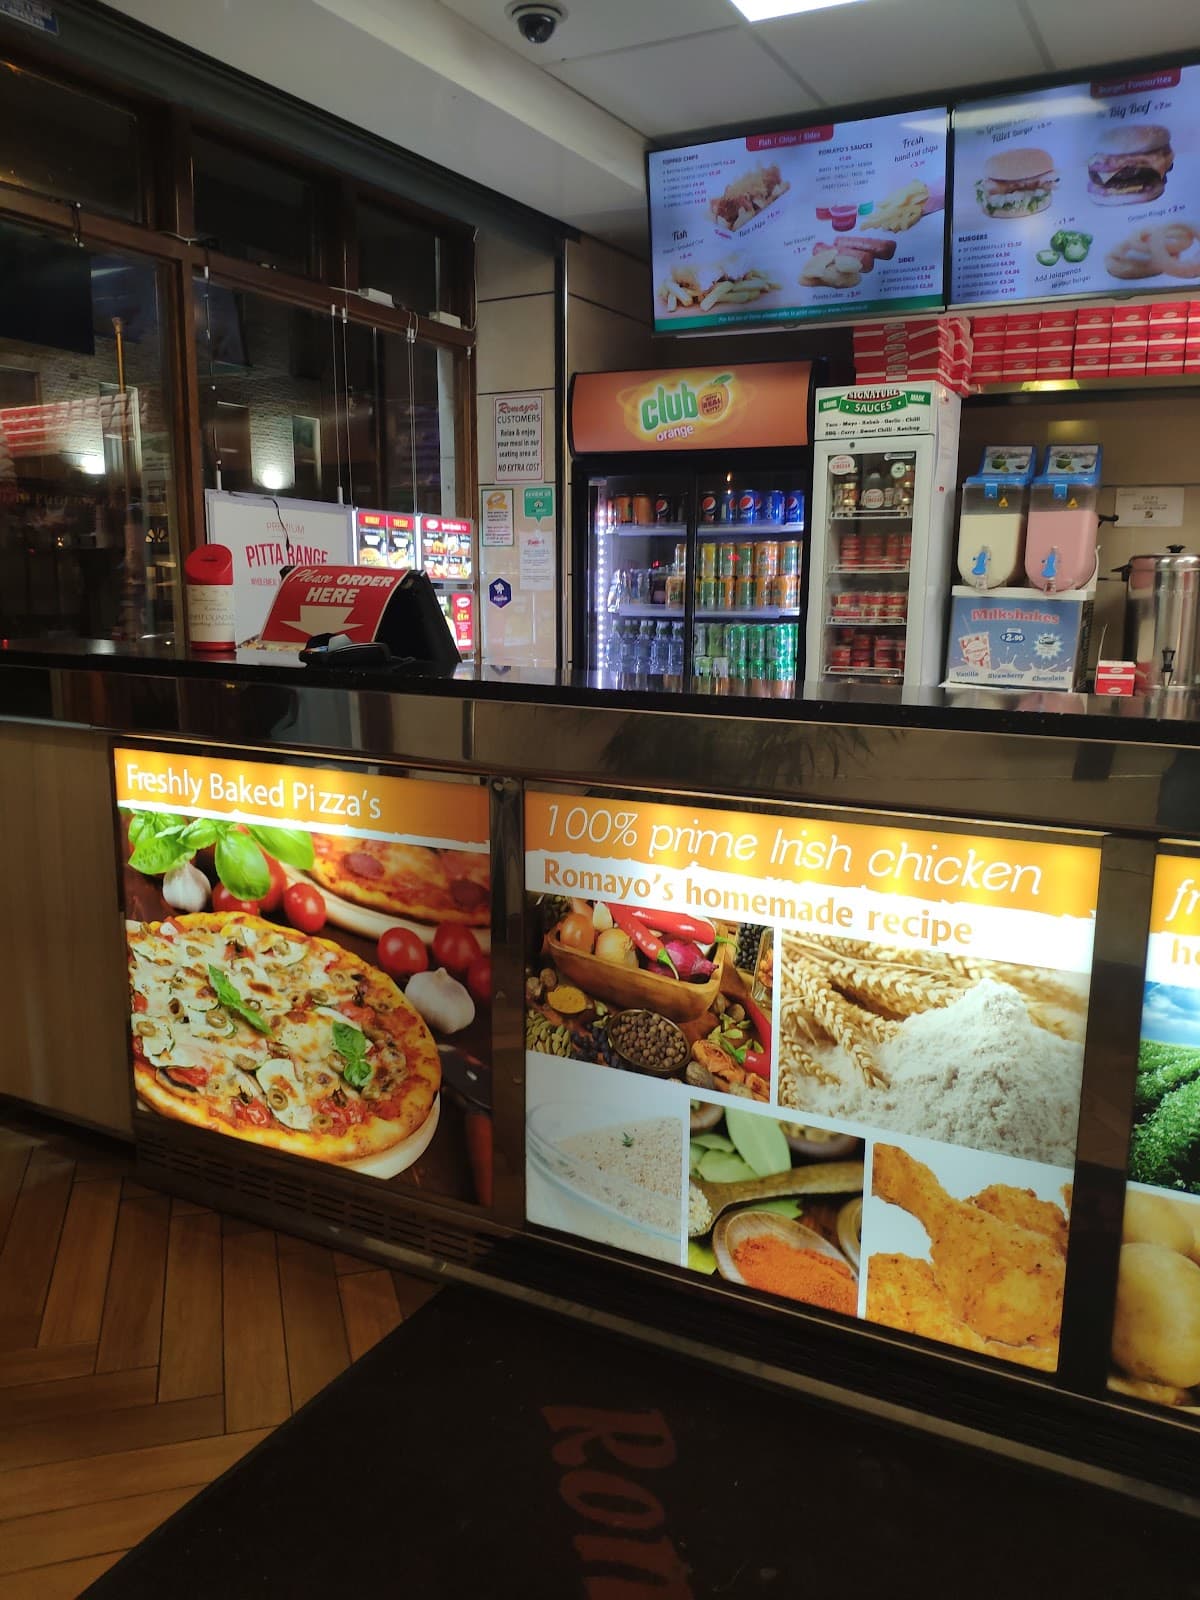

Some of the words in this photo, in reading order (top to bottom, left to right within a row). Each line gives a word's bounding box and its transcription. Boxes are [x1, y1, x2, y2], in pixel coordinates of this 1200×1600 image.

[1128, 75, 1172, 89] Favourites
[1110, 105, 1126, 119] Big
[1130, 100, 1152, 115] Beef
[850, 142, 873, 151] SAUCES
[958, 233, 988, 243] BURGERS
[847, 389, 900, 401] SIGNATURE
[854, 401, 892, 413] SAUCES
[497, 415, 541, 424] CUSTOMERS
[500, 429, 515, 437] Relax
[521, 428, 536, 438] enjoy
[656, 425, 694, 442] orange
[499, 450, 518, 458] seating
[498, 463, 507, 472] NO
[507, 463, 525, 472] EXTRA
[525, 462, 540, 471] COST
[245, 543, 284, 568] PITTA
[287, 543, 329, 566] RANGE
[288, 568, 332, 584] Please
[336, 574, 395, 588] ORDER
[305, 588, 360, 604] HERE
[971, 607, 1060, 625] Milkshakes
[987, 672, 1024, 681] Strawberry
[126, 763, 203, 805] Freshly
[210, 773, 285, 809] Baked
[292, 782, 382, 820] Pizza's
[548, 803, 639, 848] 100%
[648, 818, 759, 861] prime
[768, 827, 853, 874] Irish
[867, 841, 1043, 896] chicken
[543, 857, 675, 901] Romayo's
[686, 878, 854, 928] homemade
[866, 908, 973, 946] recipe
